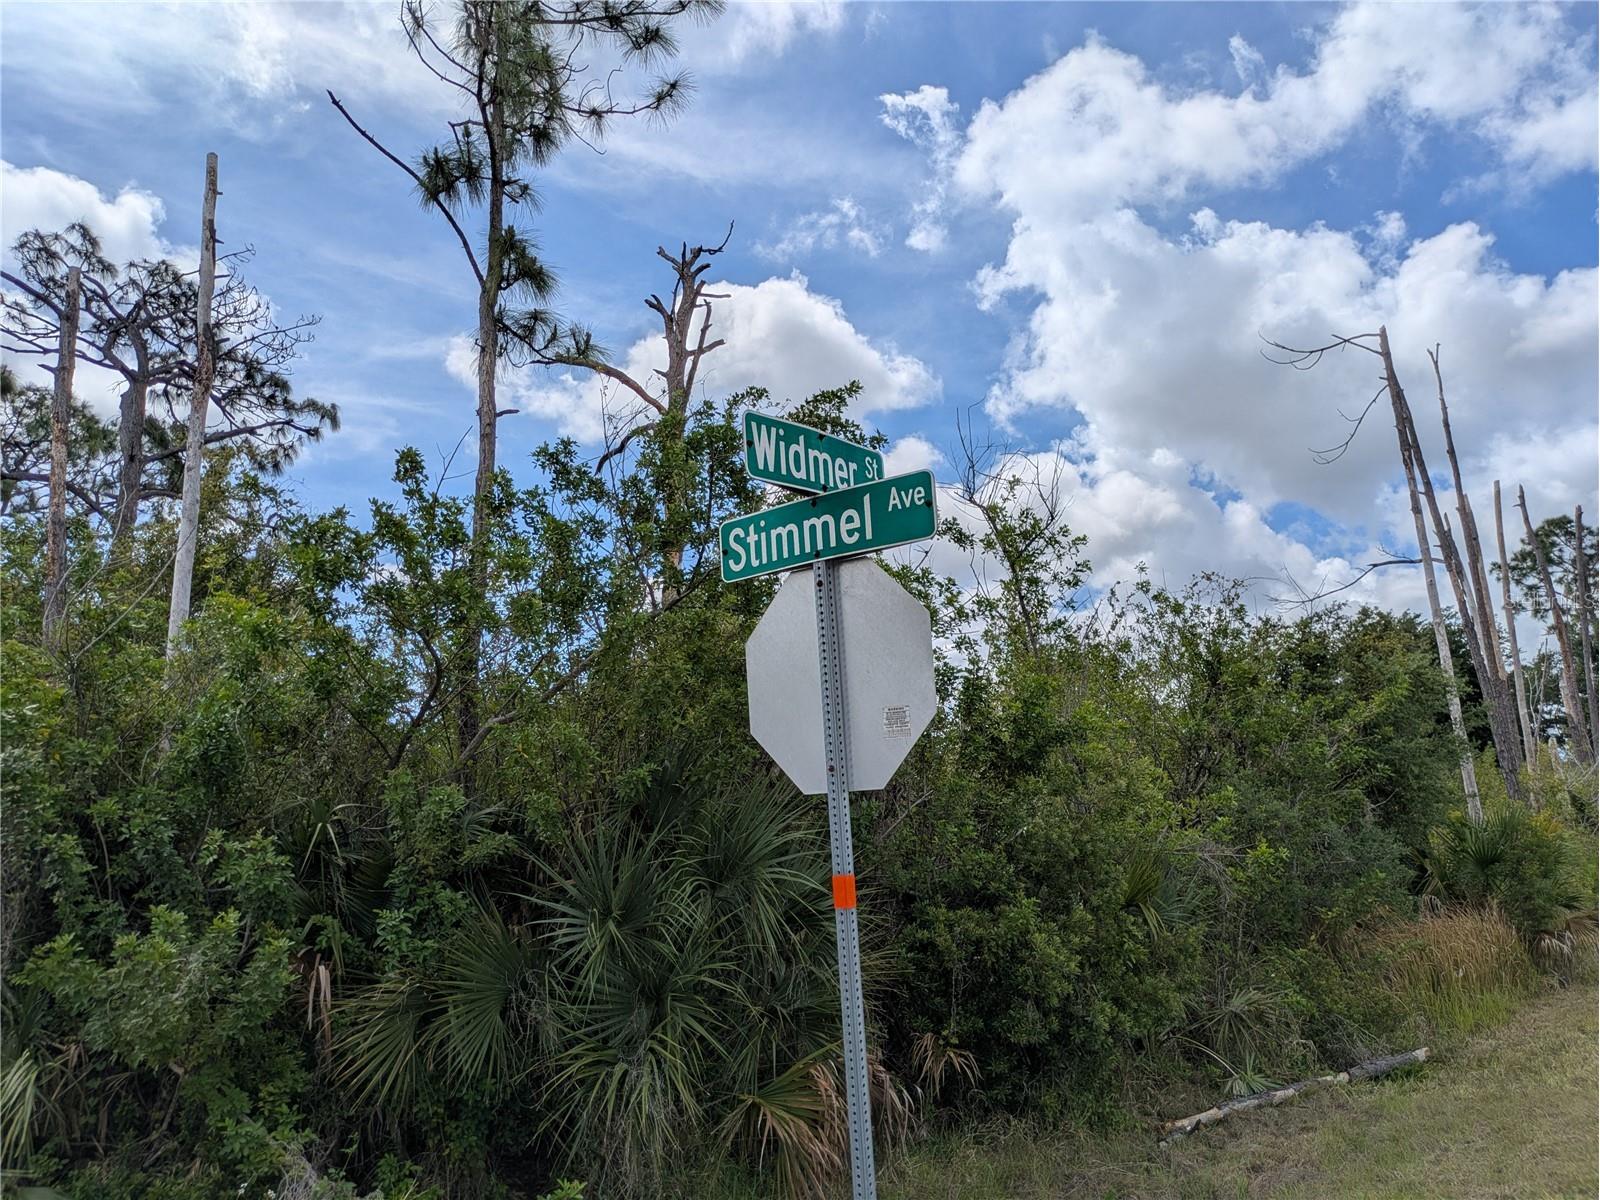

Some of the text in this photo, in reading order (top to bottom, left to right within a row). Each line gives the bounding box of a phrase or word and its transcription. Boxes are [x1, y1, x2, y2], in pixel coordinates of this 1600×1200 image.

[751, 421, 879, 489] Widmer St
[728, 486, 926, 573] Stimmel Ave
